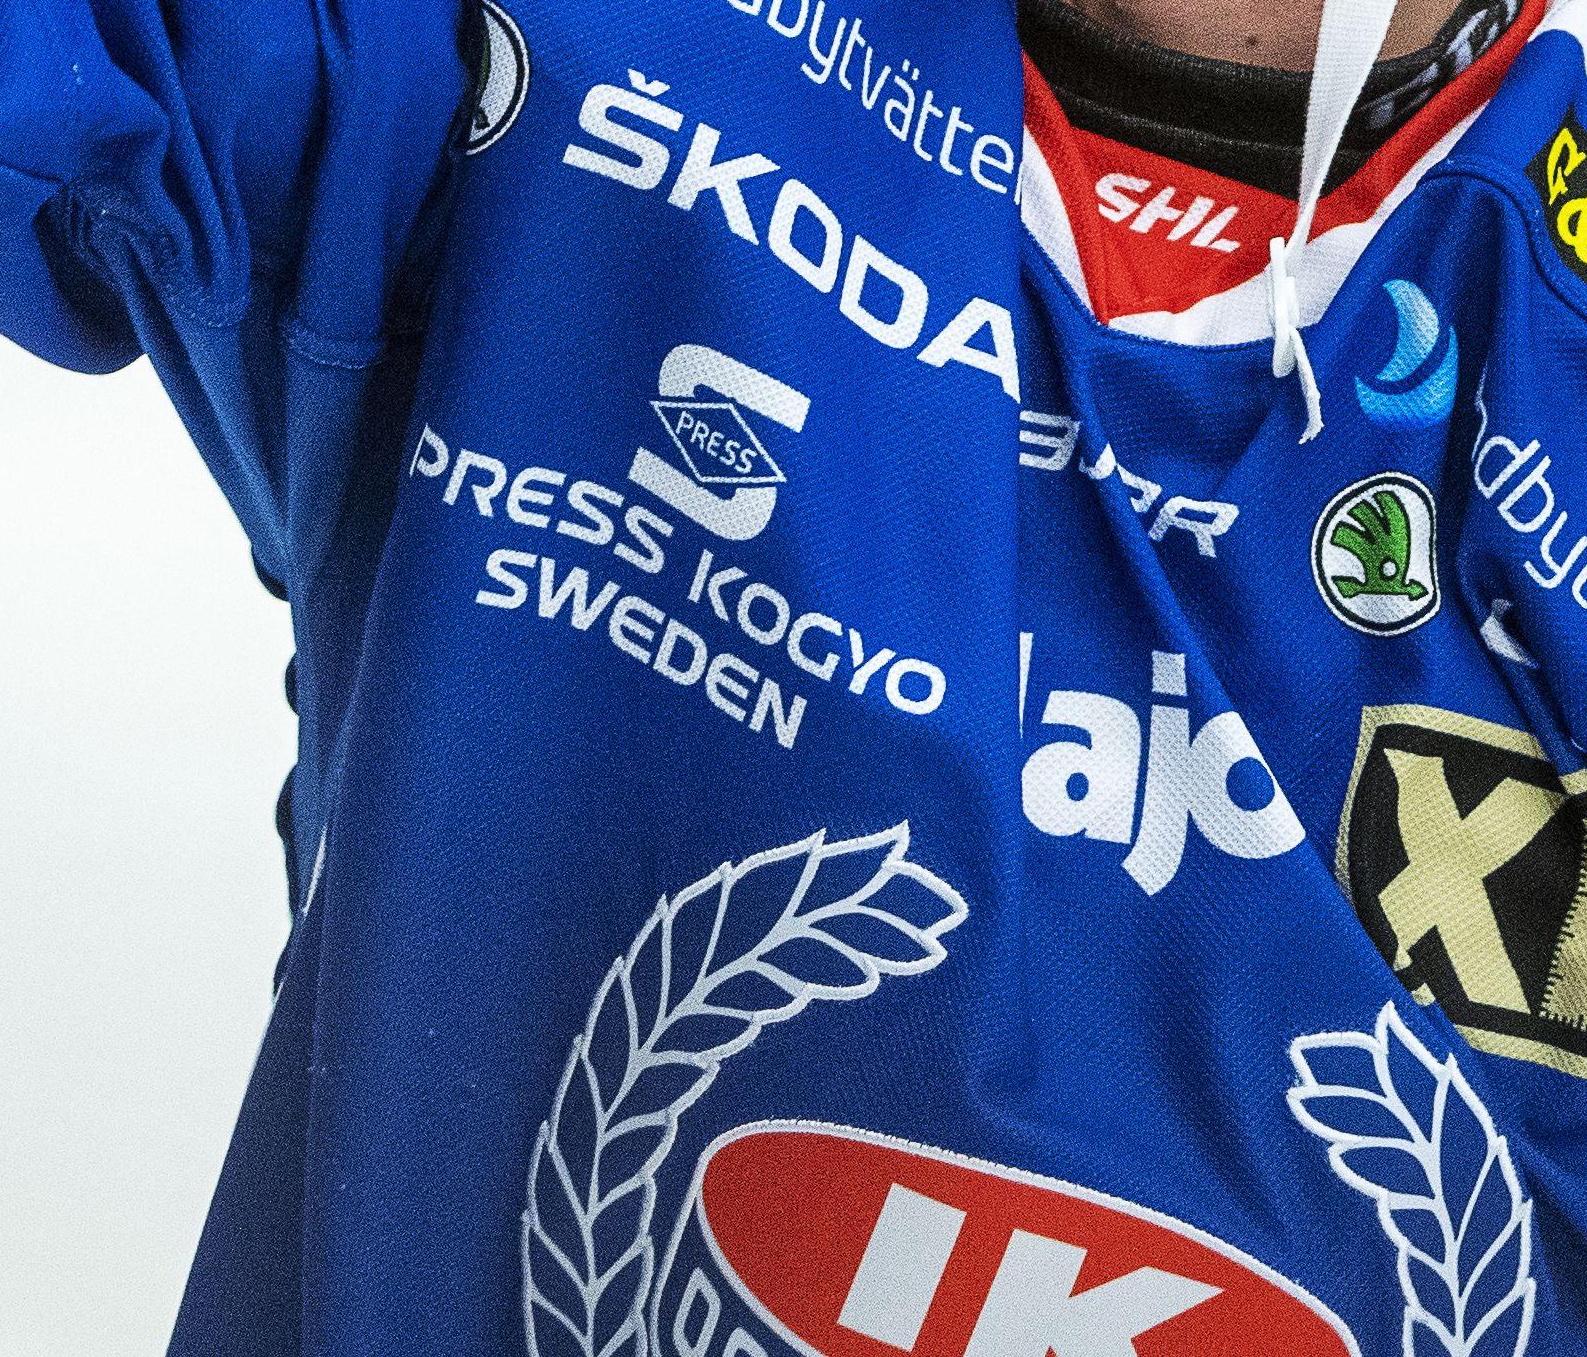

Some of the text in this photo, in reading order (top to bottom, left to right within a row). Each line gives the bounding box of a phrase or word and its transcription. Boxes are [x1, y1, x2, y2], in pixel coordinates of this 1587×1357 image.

[562, 68, 1021, 404] ŠKODA
[1095, 172, 1241, 253] SHL
[675, 408, 757, 476] PRESS
[410, 423, 947, 716] PRESS KOGYO
[475, 548, 808, 750] SWEDEN
[1018, 631, 1307, 896] ajo
[835, 1182, 1225, 1357] IK
